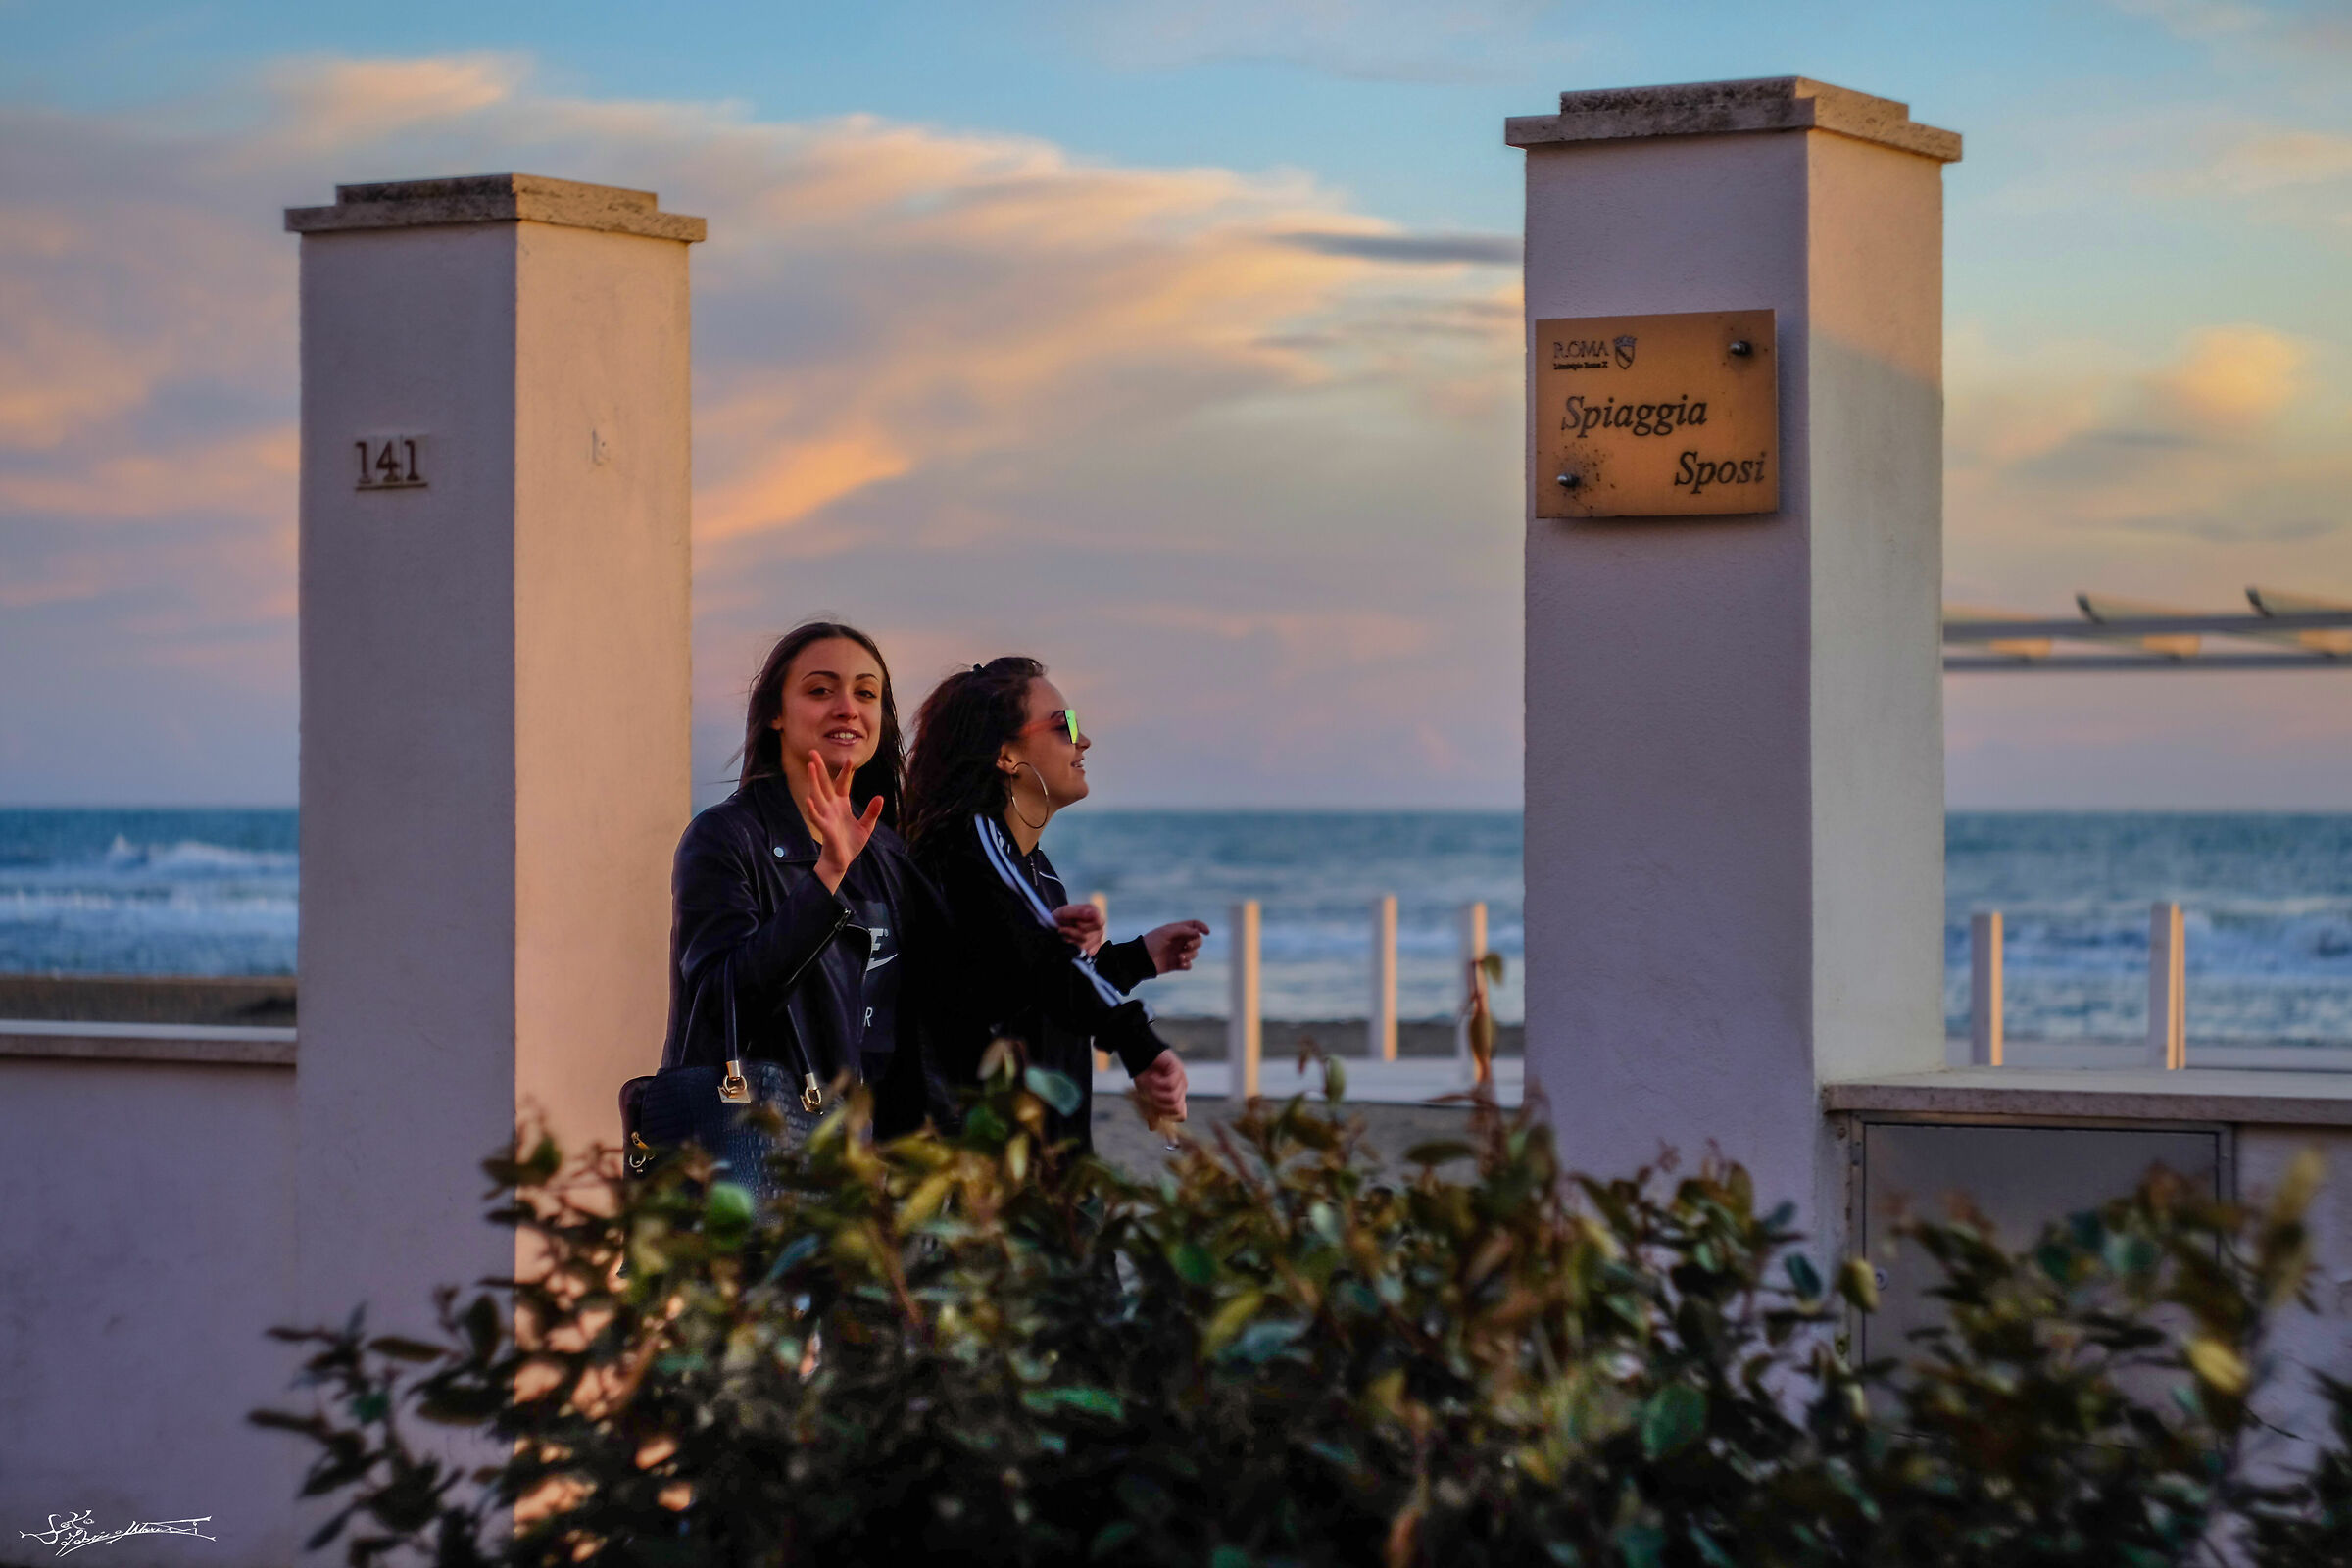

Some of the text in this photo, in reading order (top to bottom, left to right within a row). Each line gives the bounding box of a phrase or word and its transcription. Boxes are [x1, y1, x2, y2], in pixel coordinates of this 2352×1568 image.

[1553, 340, 1609, 358] ROMA
[1561, 394, 1708, 438] Spiaggia
[355, 439, 420, 484] 141
[1674, 451, 1768, 494] Sposi
